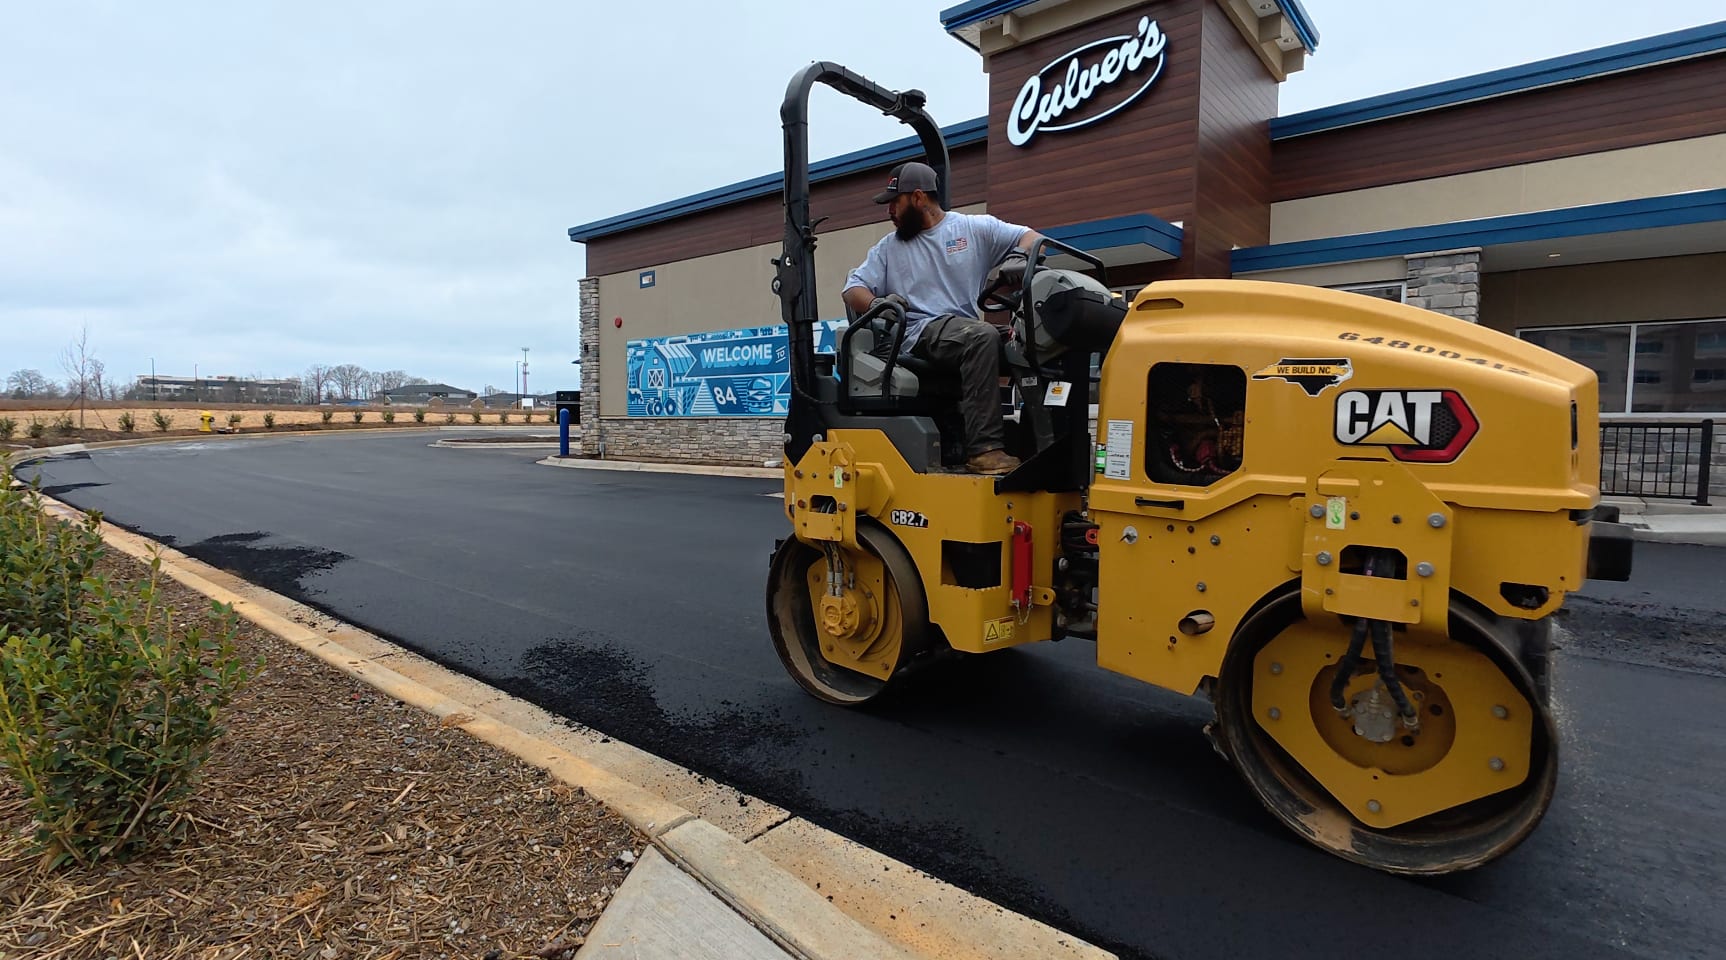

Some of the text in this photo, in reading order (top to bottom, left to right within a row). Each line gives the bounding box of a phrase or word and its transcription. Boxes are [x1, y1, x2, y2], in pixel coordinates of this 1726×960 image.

[1007, 16, 1166, 147] Culver's
[702, 343, 785, 364] WELCOME TO
[1277, 366, 1331, 374] WE BUILD NC
[713, 386, 737, 405] 84
[1336, 391, 1442, 446] CAT
[891, 510, 926, 527] CB2.7
